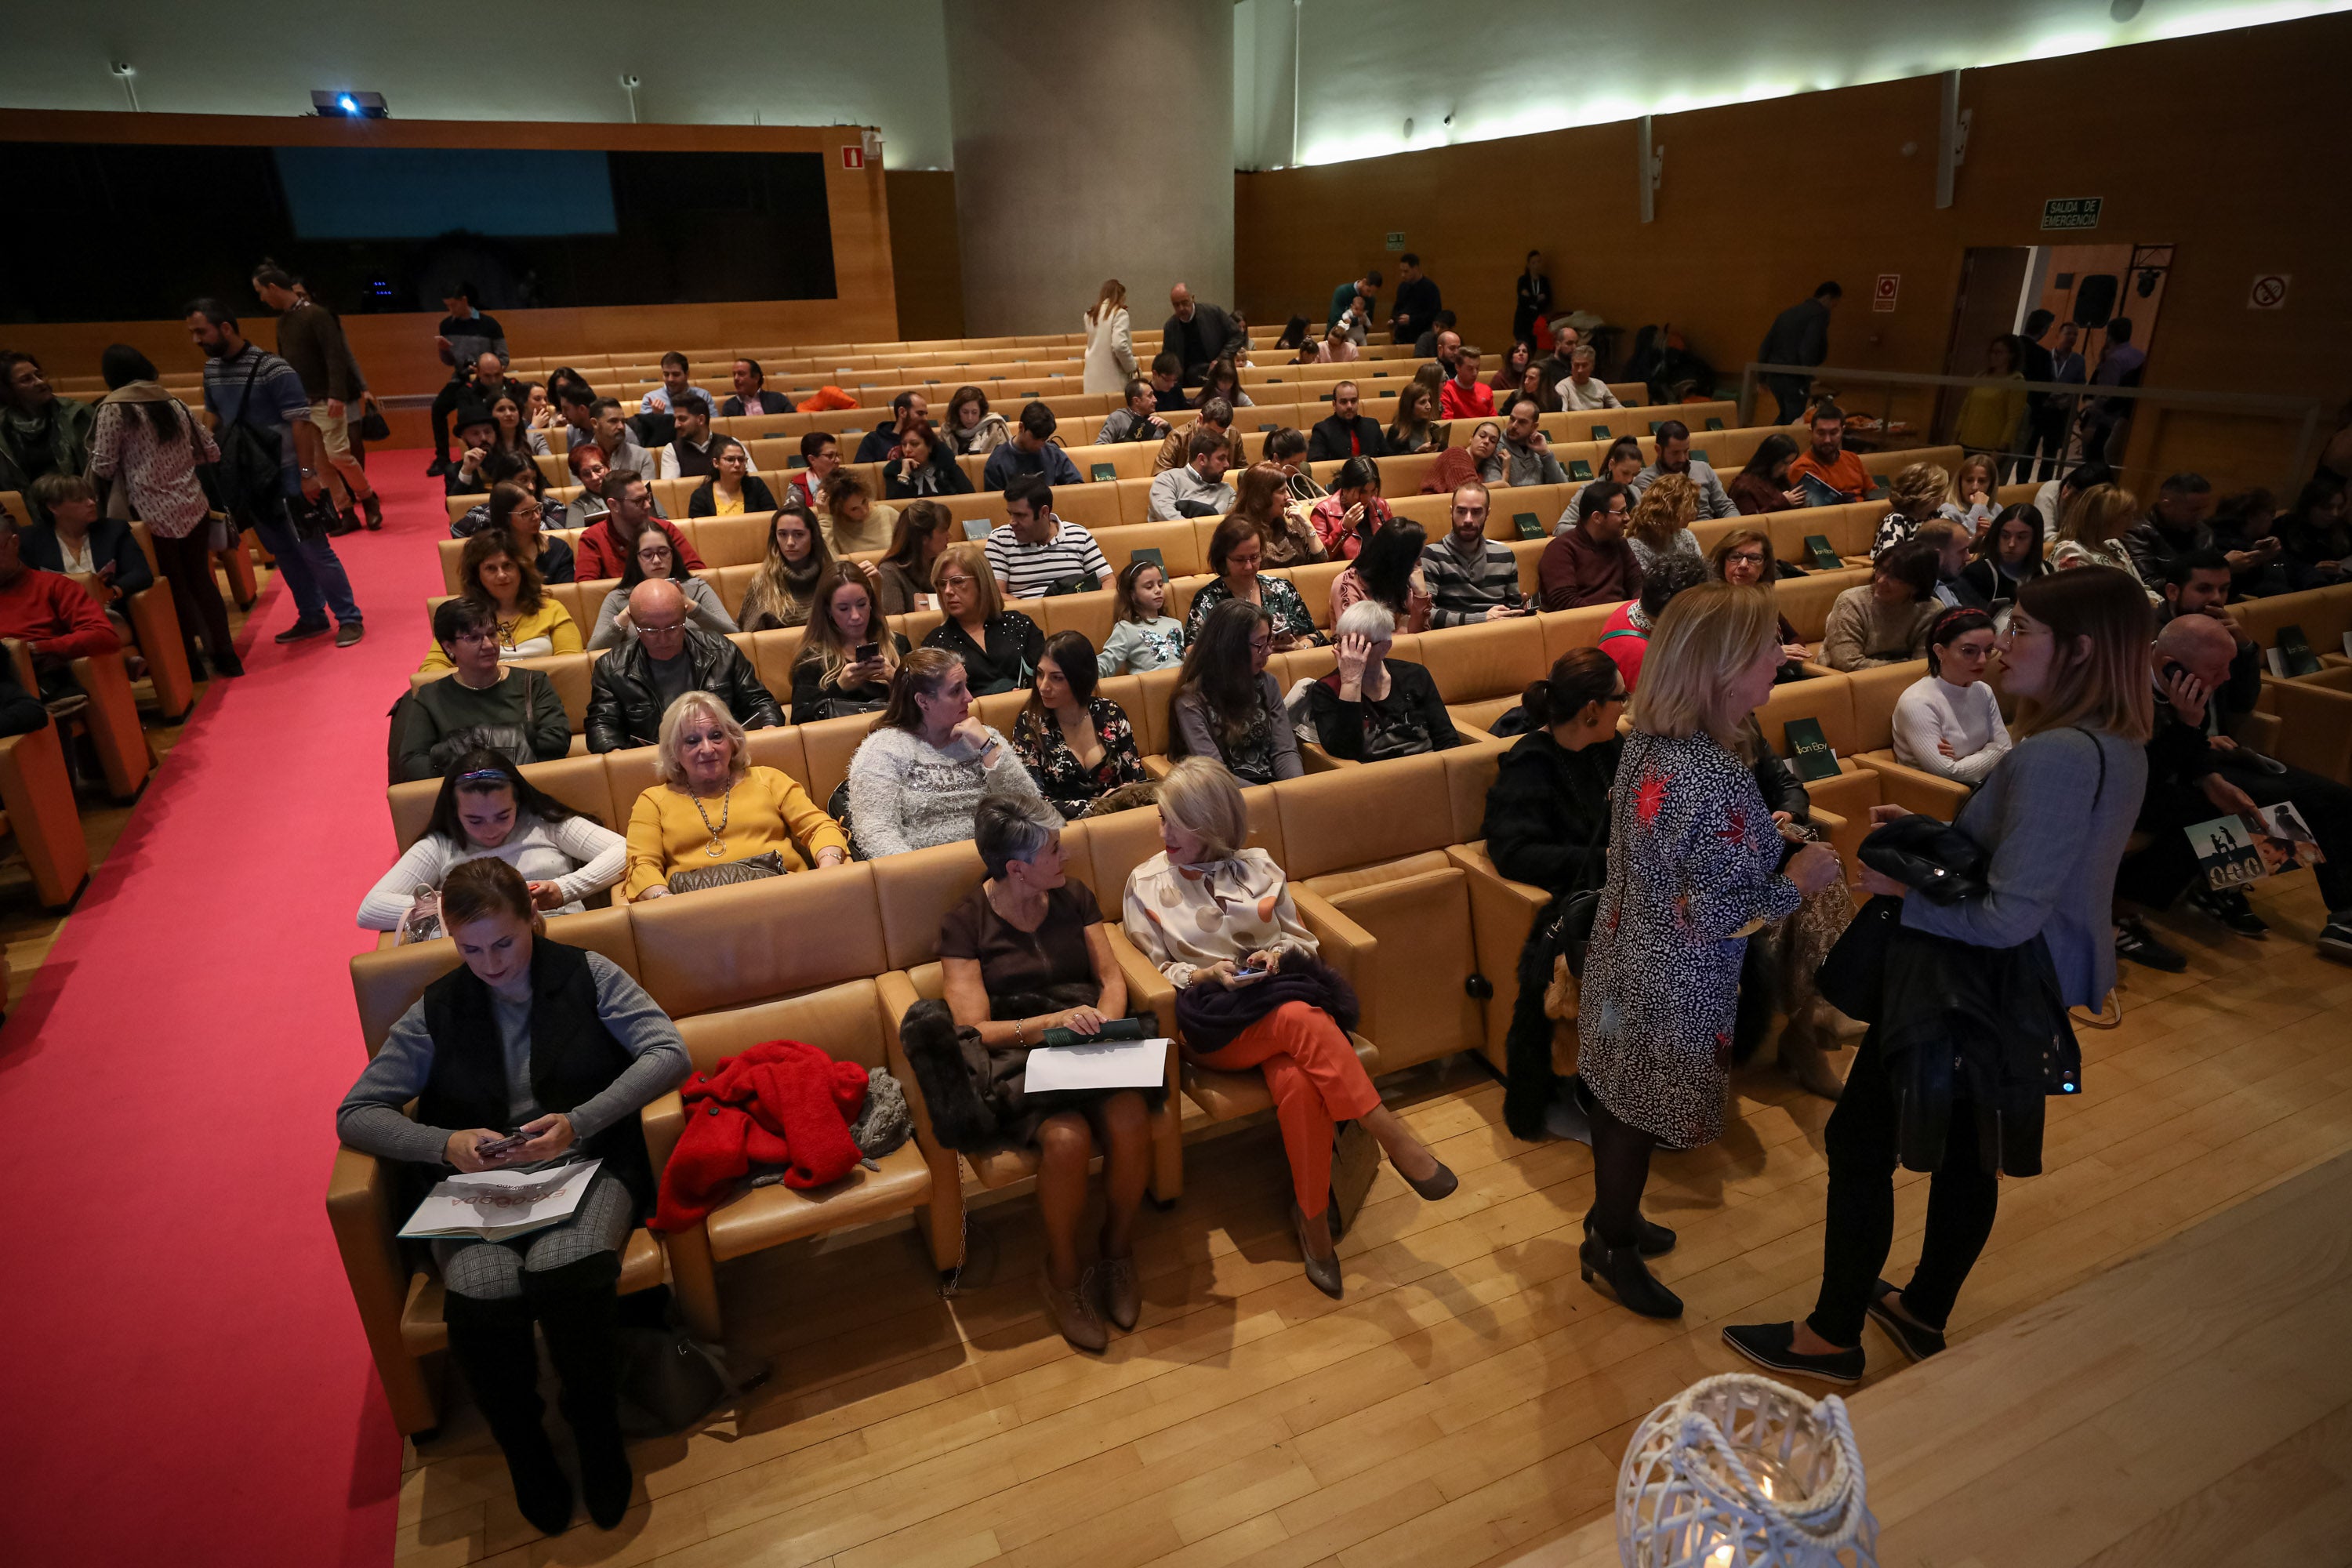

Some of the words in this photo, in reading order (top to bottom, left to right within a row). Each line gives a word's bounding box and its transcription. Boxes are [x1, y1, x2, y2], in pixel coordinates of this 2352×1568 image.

[2050, 201, 2078, 214] SALIDA
[2084, 200, 2097, 212] DE
[2044, 213, 2096, 227] EMERGENCIA
